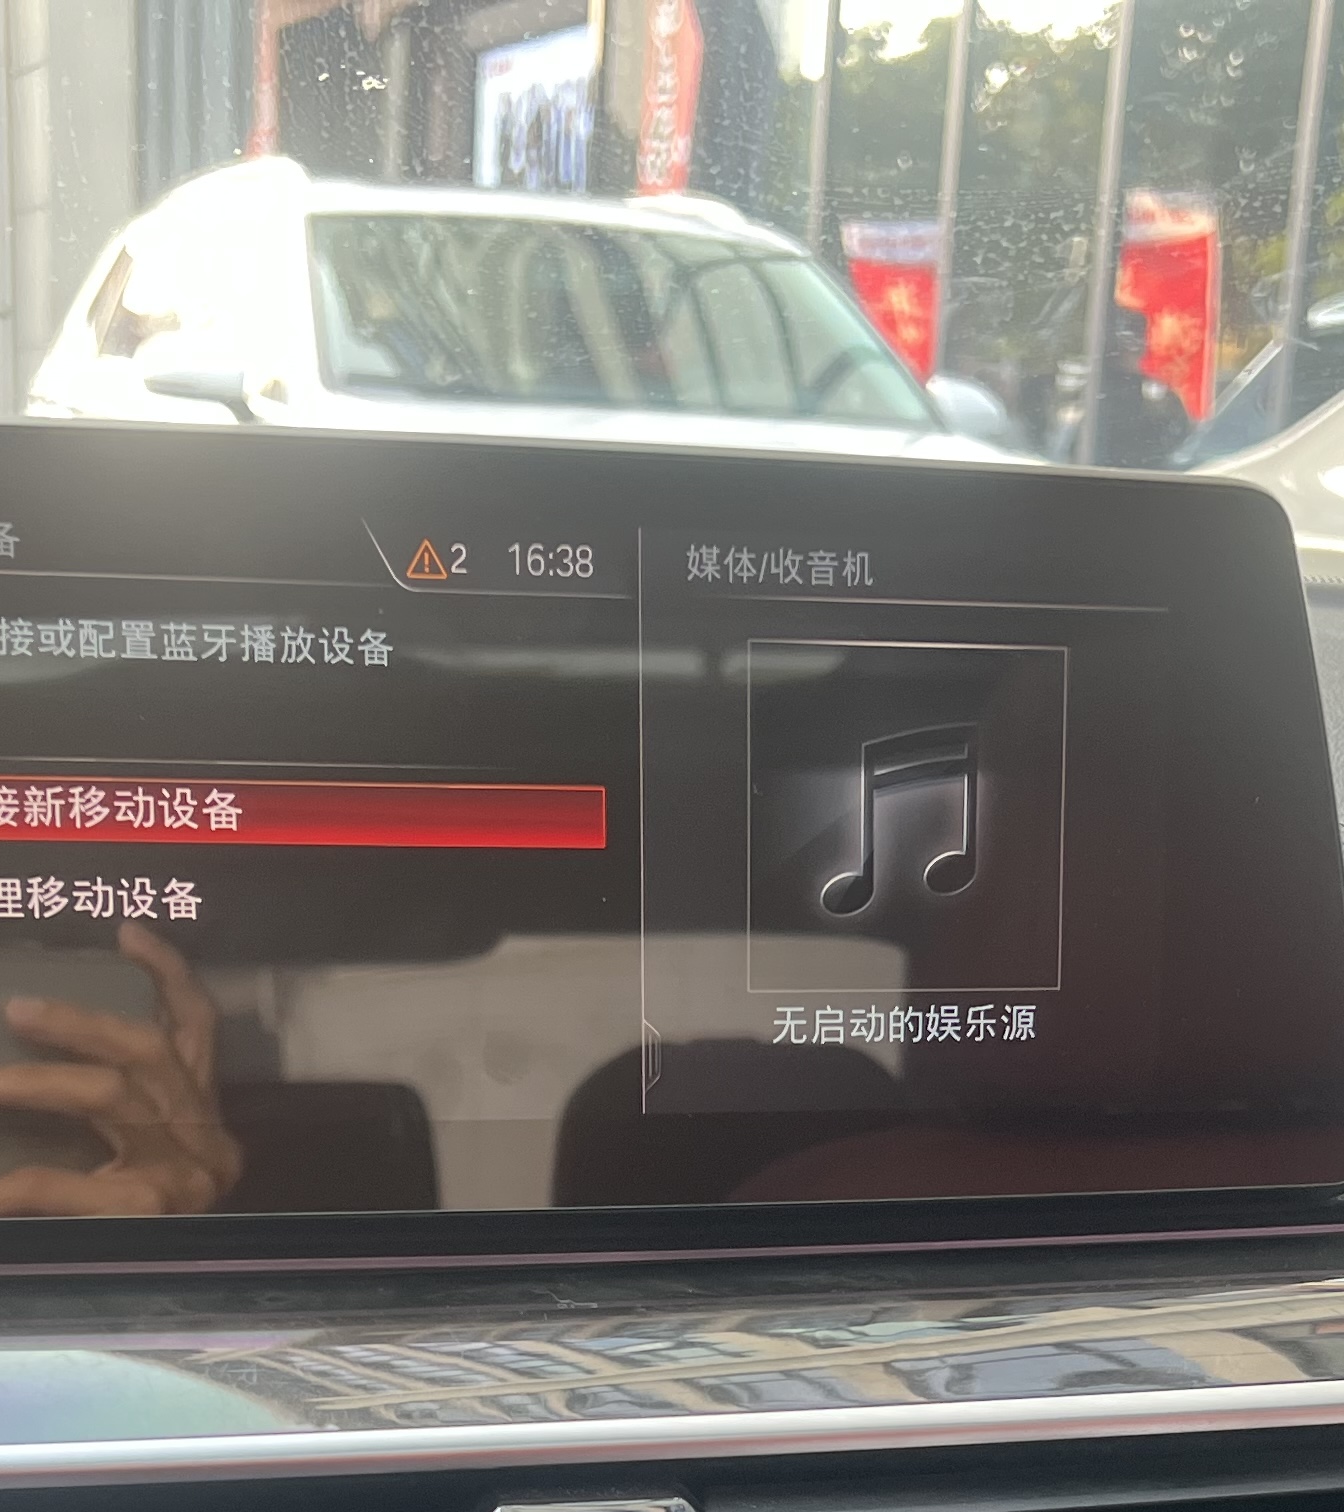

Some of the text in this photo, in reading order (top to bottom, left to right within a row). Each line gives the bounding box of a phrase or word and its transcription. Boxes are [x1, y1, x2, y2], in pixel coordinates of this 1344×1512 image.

[449, 541, 595, 580] 2 16:38
[685, 543, 875, 588] 媒体/收音机
[772, 1004, 1038, 1046] 无启动的娱乐源
